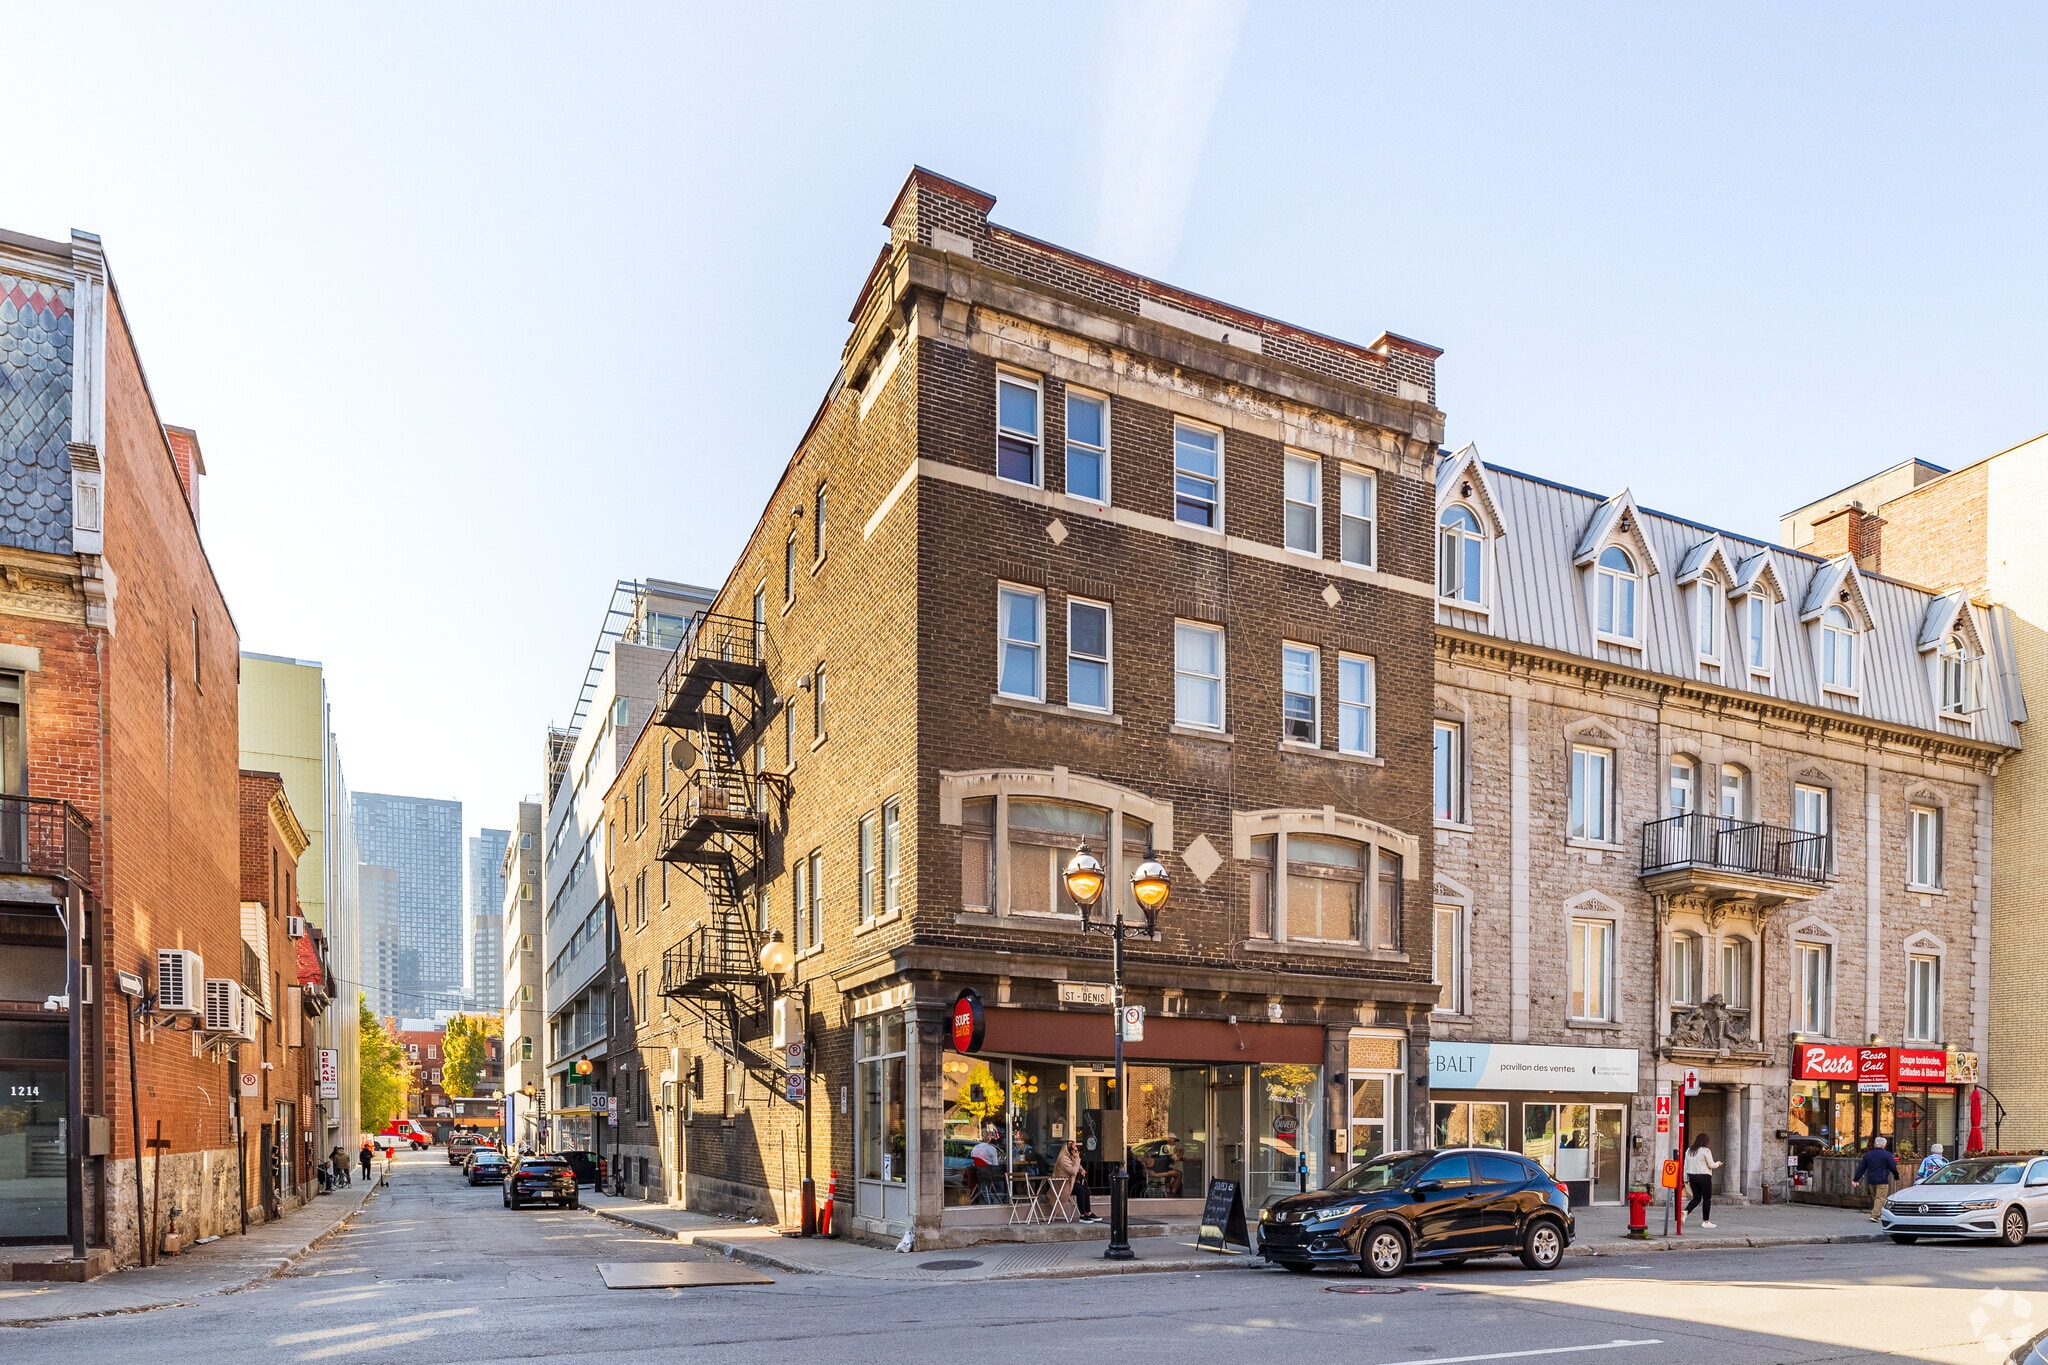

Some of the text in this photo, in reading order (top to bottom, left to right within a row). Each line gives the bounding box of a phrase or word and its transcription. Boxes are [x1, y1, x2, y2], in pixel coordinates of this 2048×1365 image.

[955, 1013, 970, 1027] SOUPE
[1805, 1047, 1855, 1074] Resto
[1860, 1050, 1888, 1060] Resto
[1900, 1055, 1942, 1066] Soupe tonkinoise,
[321, 1051, 330, 1082] DEPAN
[1436, 1055, 1476, 1073] BALT
[1500, 1062, 1576, 1073] pavillon des ventes
[1861, 1060, 1885, 1072] Cali
[1900, 1067, 1921, 1077] Grillades
[10, 1086, 40, 1096] 1214
[592, 1096, 606, 1107] 30
